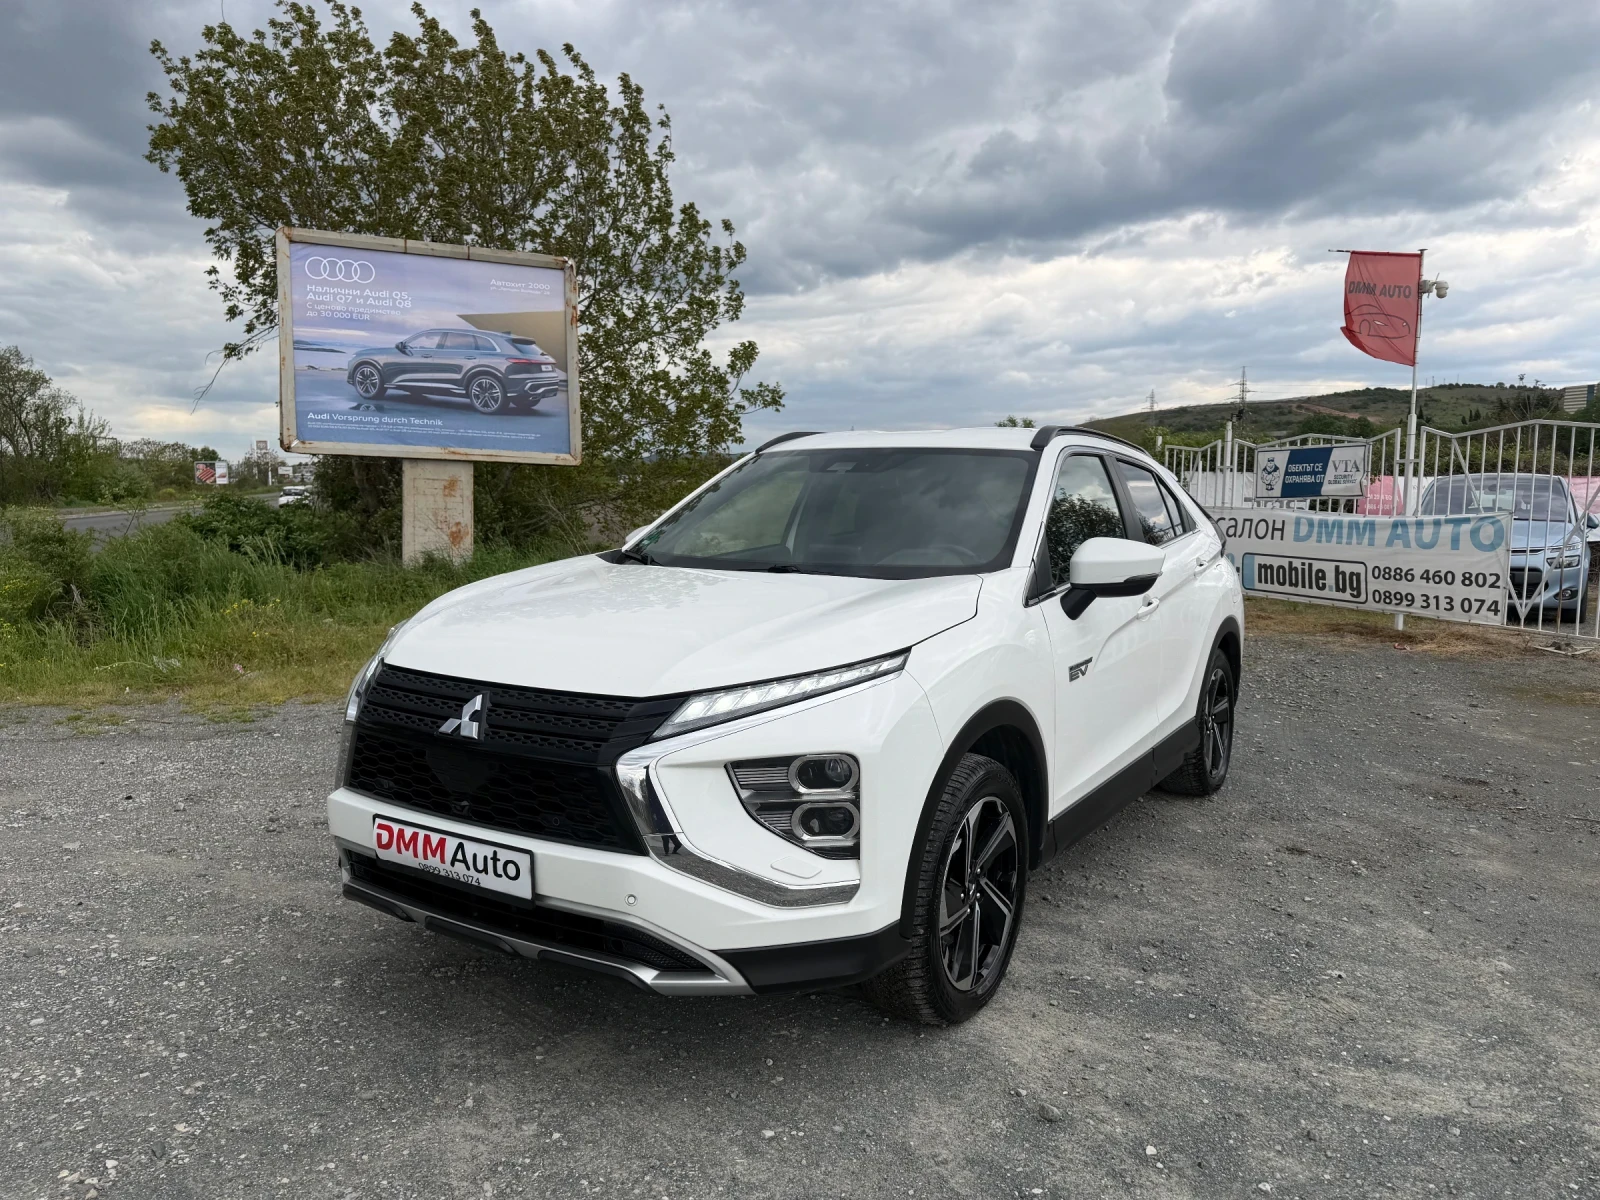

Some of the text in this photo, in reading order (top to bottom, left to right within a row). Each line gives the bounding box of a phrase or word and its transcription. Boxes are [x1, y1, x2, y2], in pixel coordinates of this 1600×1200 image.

[306, 284, 412, 301] Налични Audi Q5,
[528, 282, 550, 290] 2000
[1348, 281, 1412, 299] DMM AUTO
[306, 292, 333, 302] Audi
[336, 294, 353, 303] Q7
[366, 297, 393, 307] Audi
[395, 299, 412, 308] Q8
[314, 303, 347, 312] ценово
[348, 306, 401, 316] предимство
[333, 311, 351, 319] 000
[307, 411, 444, 426] Audi Vorsprung durch Technik
[1288, 463, 1323, 472] ОБЕКТЪТ СЕ
[1332, 460, 1360, 472] VTA
[1285, 474, 1325, 483] ОХРАНЯВА ОТ
[1292, 515, 1376, 547] DMM
[1386, 515, 1505, 552] AUTO
[1257, 560, 1362, 598] mobile.bg
[1371, 565, 1501, 589] 0886 460 802
[1372, 589, 1500, 617] 0899 313 074
[418, 862, 481, 886] 0899 313 074
